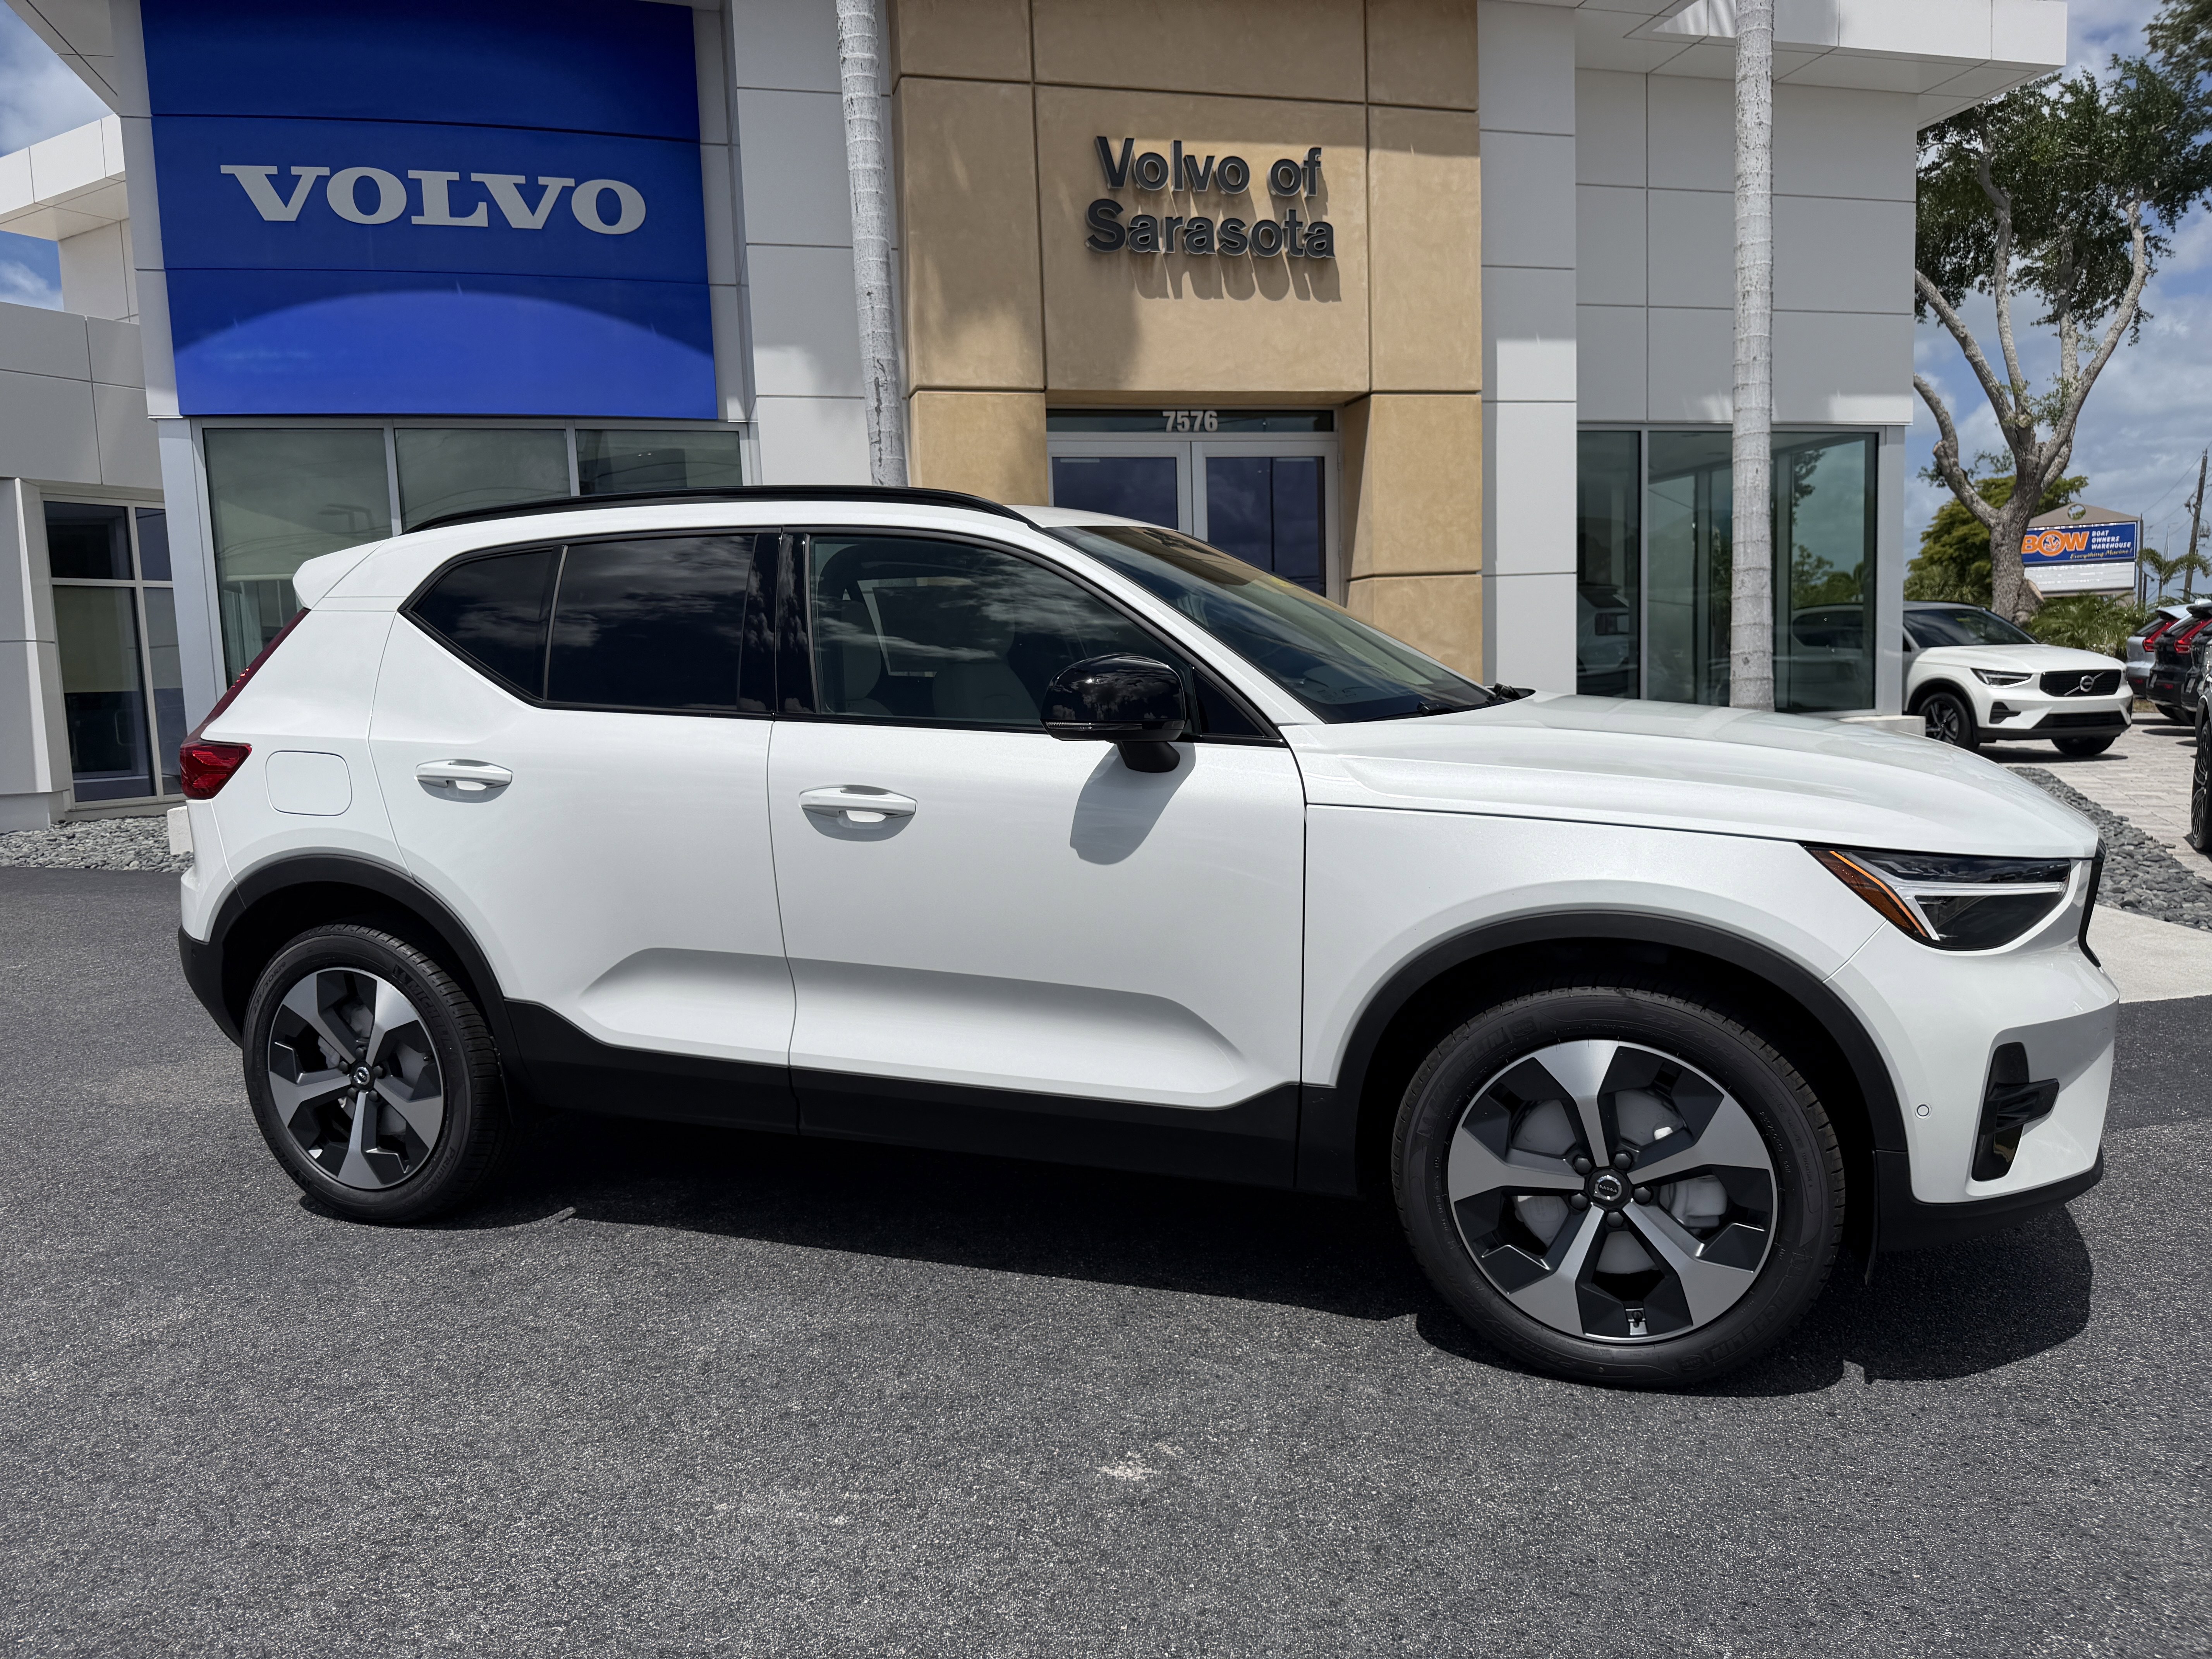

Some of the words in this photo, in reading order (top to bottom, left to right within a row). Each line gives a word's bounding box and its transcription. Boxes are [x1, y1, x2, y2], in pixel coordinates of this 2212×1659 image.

[1095, 136, 1251, 194] Volvo
[1267, 147, 1322, 197] of
[220, 165, 646, 235] VOLVO
[1085, 198, 1336, 258] Sarasota
[1162, 410, 1218, 433] 7576
[2021, 530, 2090, 557] BOW
[2070, 551, 2104, 560] Everything
[2091, 542, 2132, 550] WAREHOUSE
